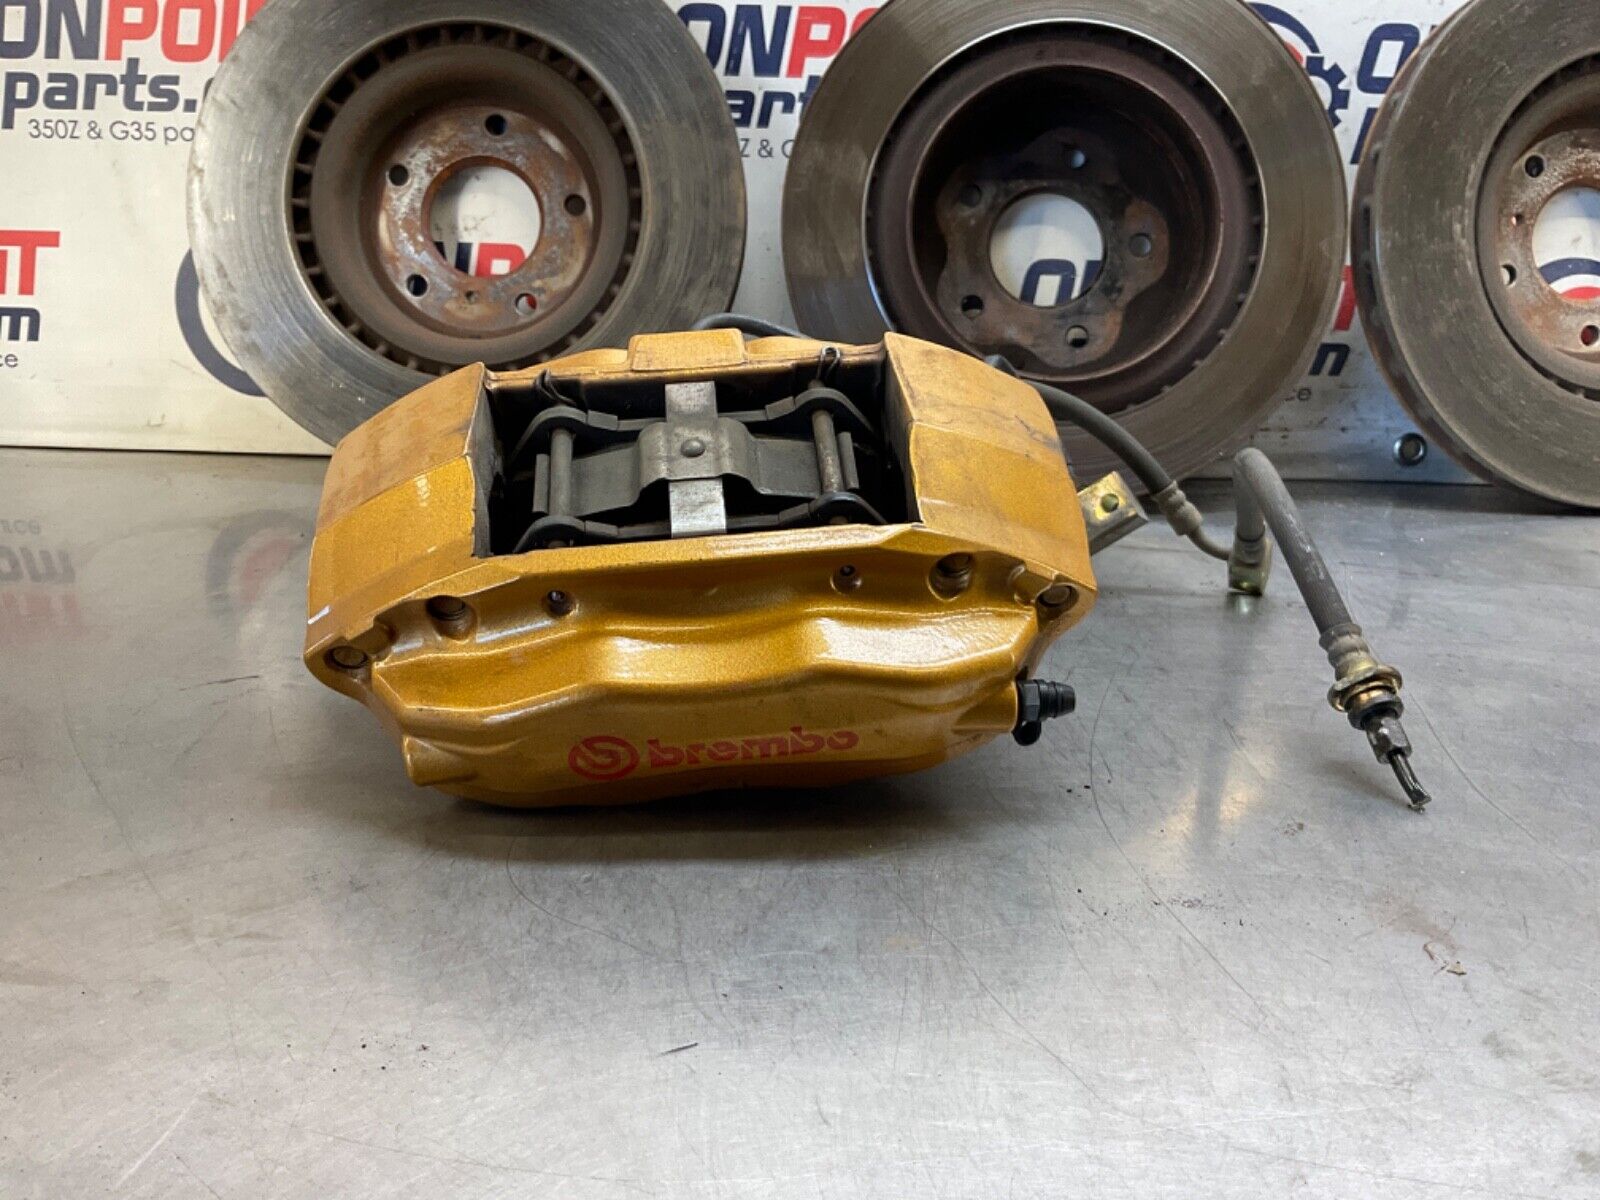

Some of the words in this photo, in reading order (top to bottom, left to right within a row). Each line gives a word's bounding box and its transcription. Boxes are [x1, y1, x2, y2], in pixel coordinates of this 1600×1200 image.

[2, 57, 214, 130] parts.
[28, 119, 80, 139] 350Z
[87, 122, 103, 140] &
[109, 121, 156, 141] G35
[646, 725, 860, 769] brembo
